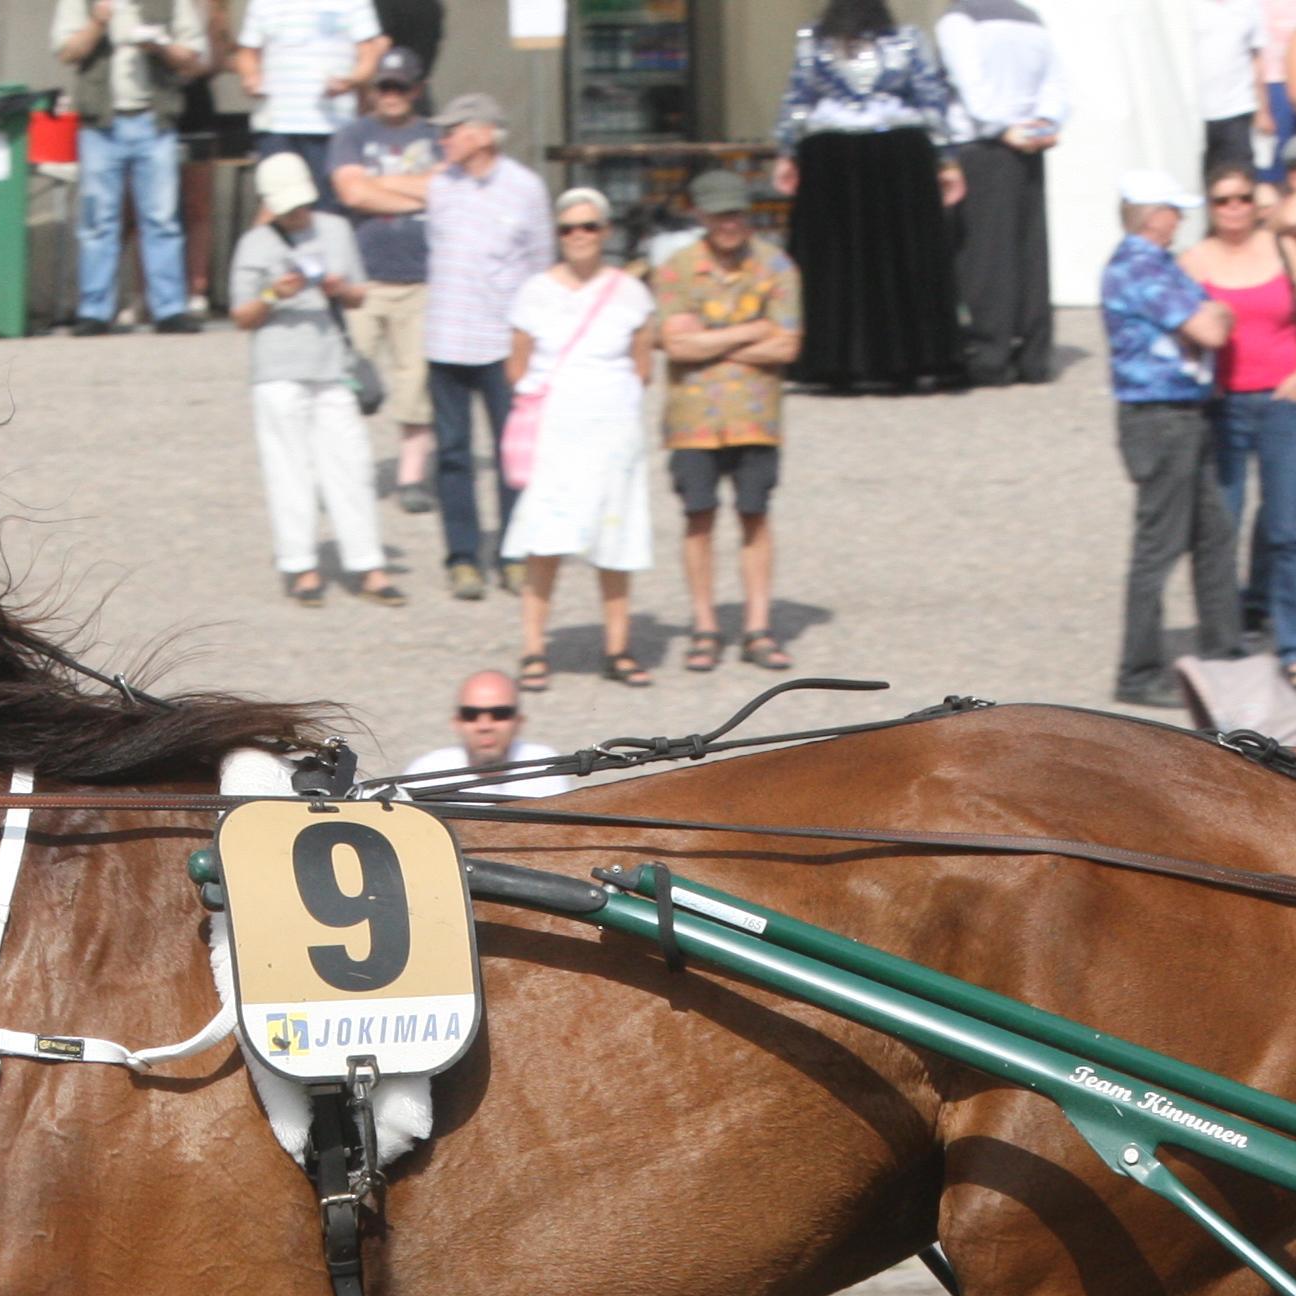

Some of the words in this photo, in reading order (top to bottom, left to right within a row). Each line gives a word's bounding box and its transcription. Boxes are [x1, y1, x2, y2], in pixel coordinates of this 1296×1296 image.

[292, 821, 411, 992] 9
[315, 1012, 461, 1048] JOKIMAA
[1068, 1066, 1132, 1102] Team
[1136, 1091, 1250, 1149] Kinnunen
